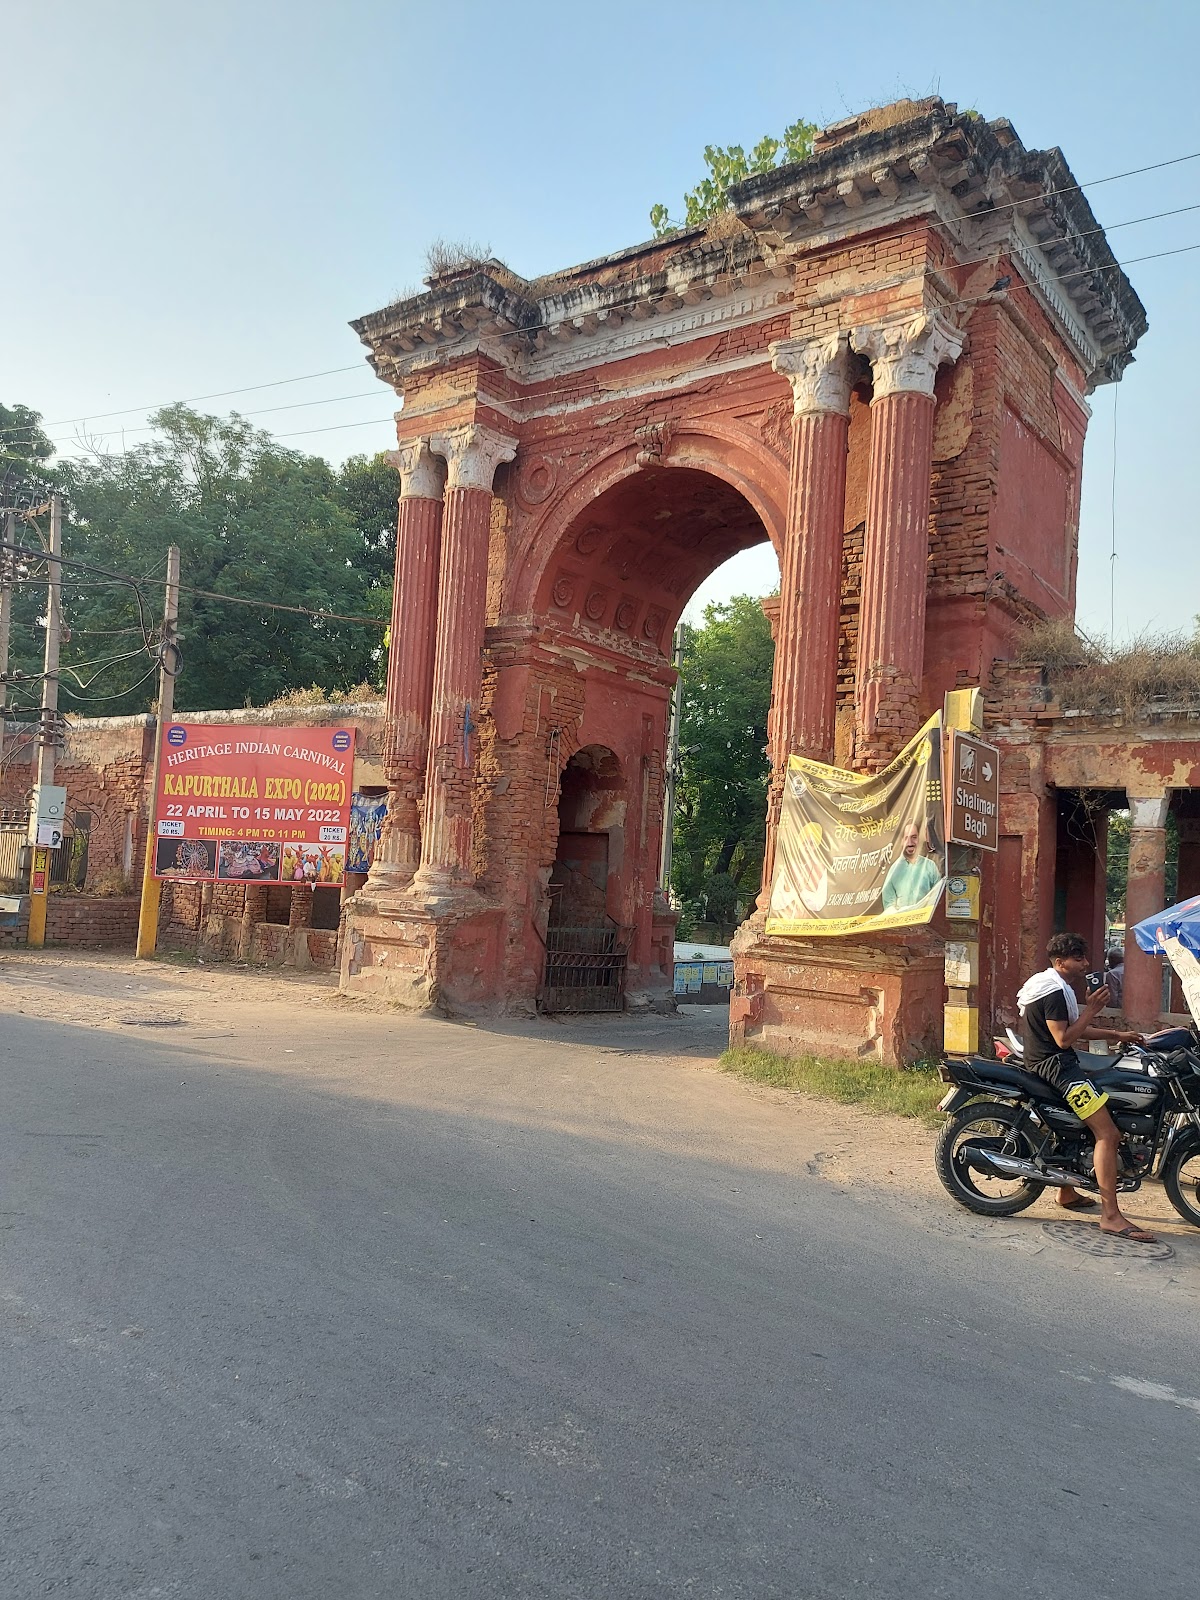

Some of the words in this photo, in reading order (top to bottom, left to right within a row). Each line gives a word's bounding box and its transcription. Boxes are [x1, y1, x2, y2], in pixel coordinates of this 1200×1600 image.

[167, 743, 233, 767] HERITAGE
[235, 742, 281, 756] INDIAN
[283, 745, 346, 775] CARNIWAL
[163, 773, 259, 798] KAPURTHALA
[264, 777, 302, 800] EXPO
[304, 778, 346, 807] (2022)
[956, 787, 996, 817] Shalimar
[166, 804, 183, 817] 22
[186, 805, 228, 819] APRIL
[231, 806, 250, 819] TO
[254, 807, 271, 820] 15
[274, 808, 305, 821] MAY
[307, 809, 341, 822] 2022
[198, 827, 235, 836] TIMING:
[237, 828, 244, 836] 4
[246, 828, 260, 837] PM
[263, 829, 275, 838] TO
[278, 829, 289, 838] 11
[291, 829, 306, 839] PM
[964, 812, 987, 839] Bagh
[827, 893, 844, 906] EACH
[1072, 1089, 1092, 1108] 23
[1134, 1086, 1152, 1094] Hero
